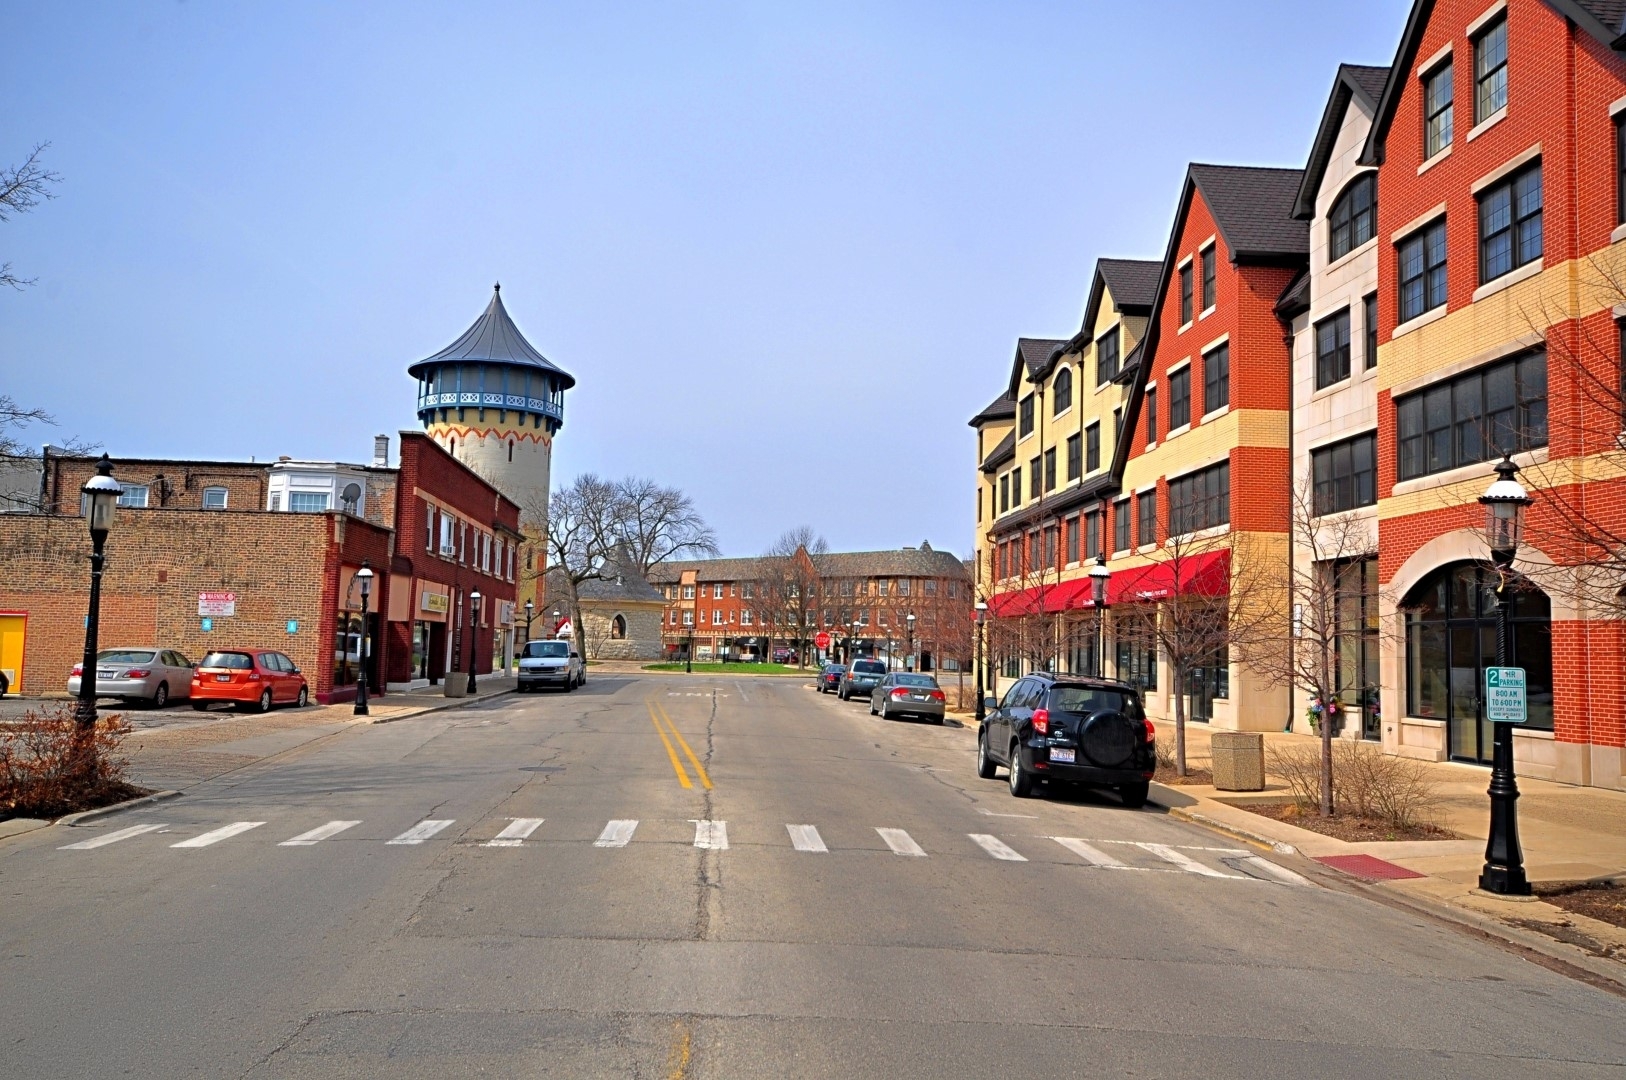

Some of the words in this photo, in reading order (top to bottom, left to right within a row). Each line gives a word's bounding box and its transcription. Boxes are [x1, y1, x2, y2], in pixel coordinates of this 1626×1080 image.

[816, 636, 830, 644] STOP
[1489, 670, 1498, 684] 2
[1499, 679, 1523, 687] PARKING
[1513, 699, 1522, 707] PM
